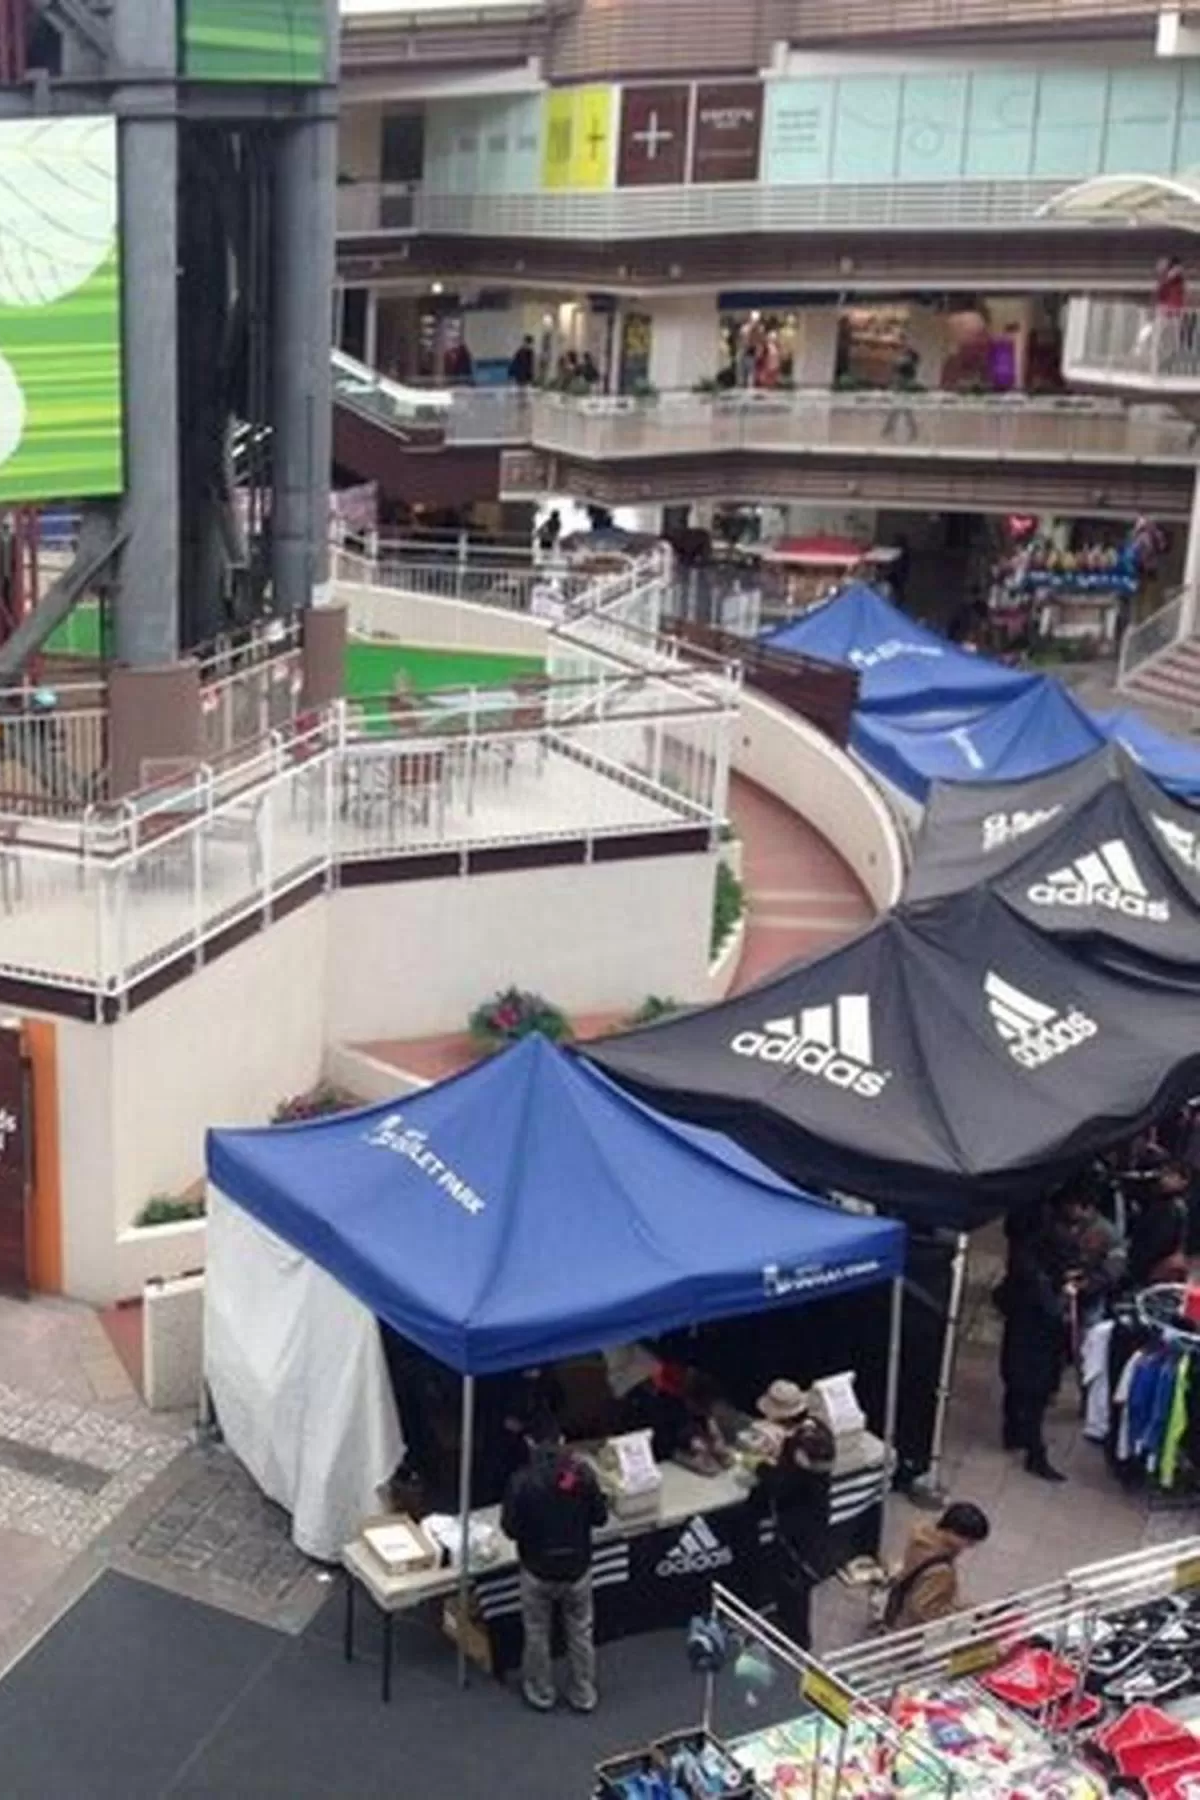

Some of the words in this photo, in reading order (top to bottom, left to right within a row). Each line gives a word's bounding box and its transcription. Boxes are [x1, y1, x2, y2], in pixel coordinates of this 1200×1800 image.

[1027, 883, 1170, 923] adidas
[1010, 1011, 1098, 1070] adidas
[730, 1030, 886, 1098] adidas
[436, 1170, 487, 1214] PARK
[656, 1548, 732, 1577] adidas
